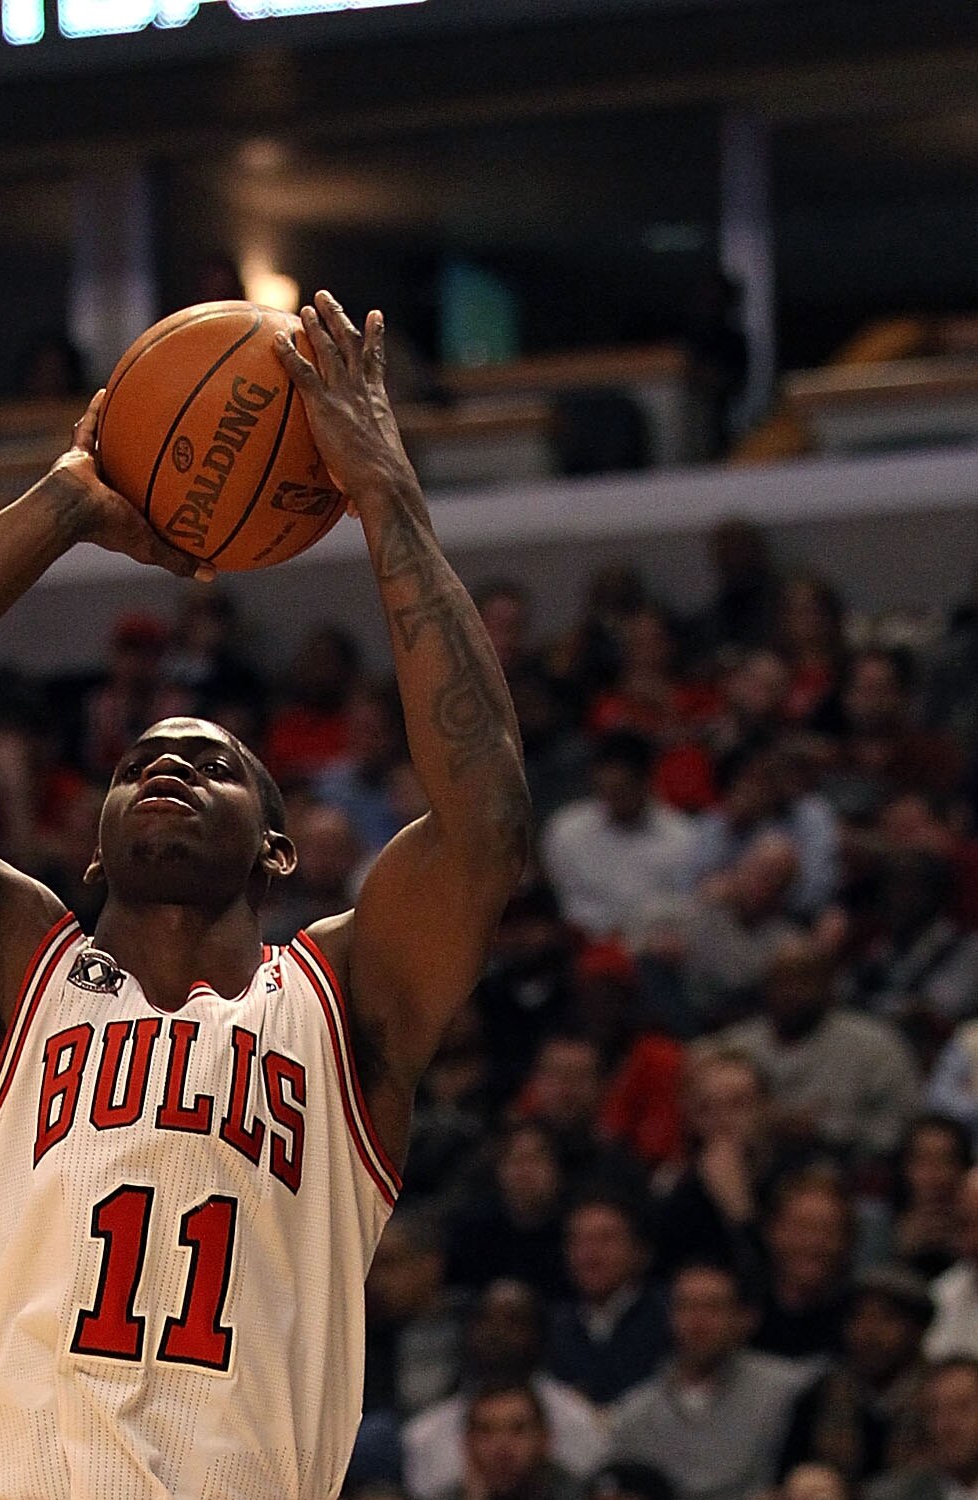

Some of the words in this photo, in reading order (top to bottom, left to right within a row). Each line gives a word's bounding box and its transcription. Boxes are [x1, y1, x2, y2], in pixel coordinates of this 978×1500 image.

[165, 375, 275, 548] SPALDING
[33, 1017, 307, 1196] BULLS
[69, 1184, 238, 1373] 11
